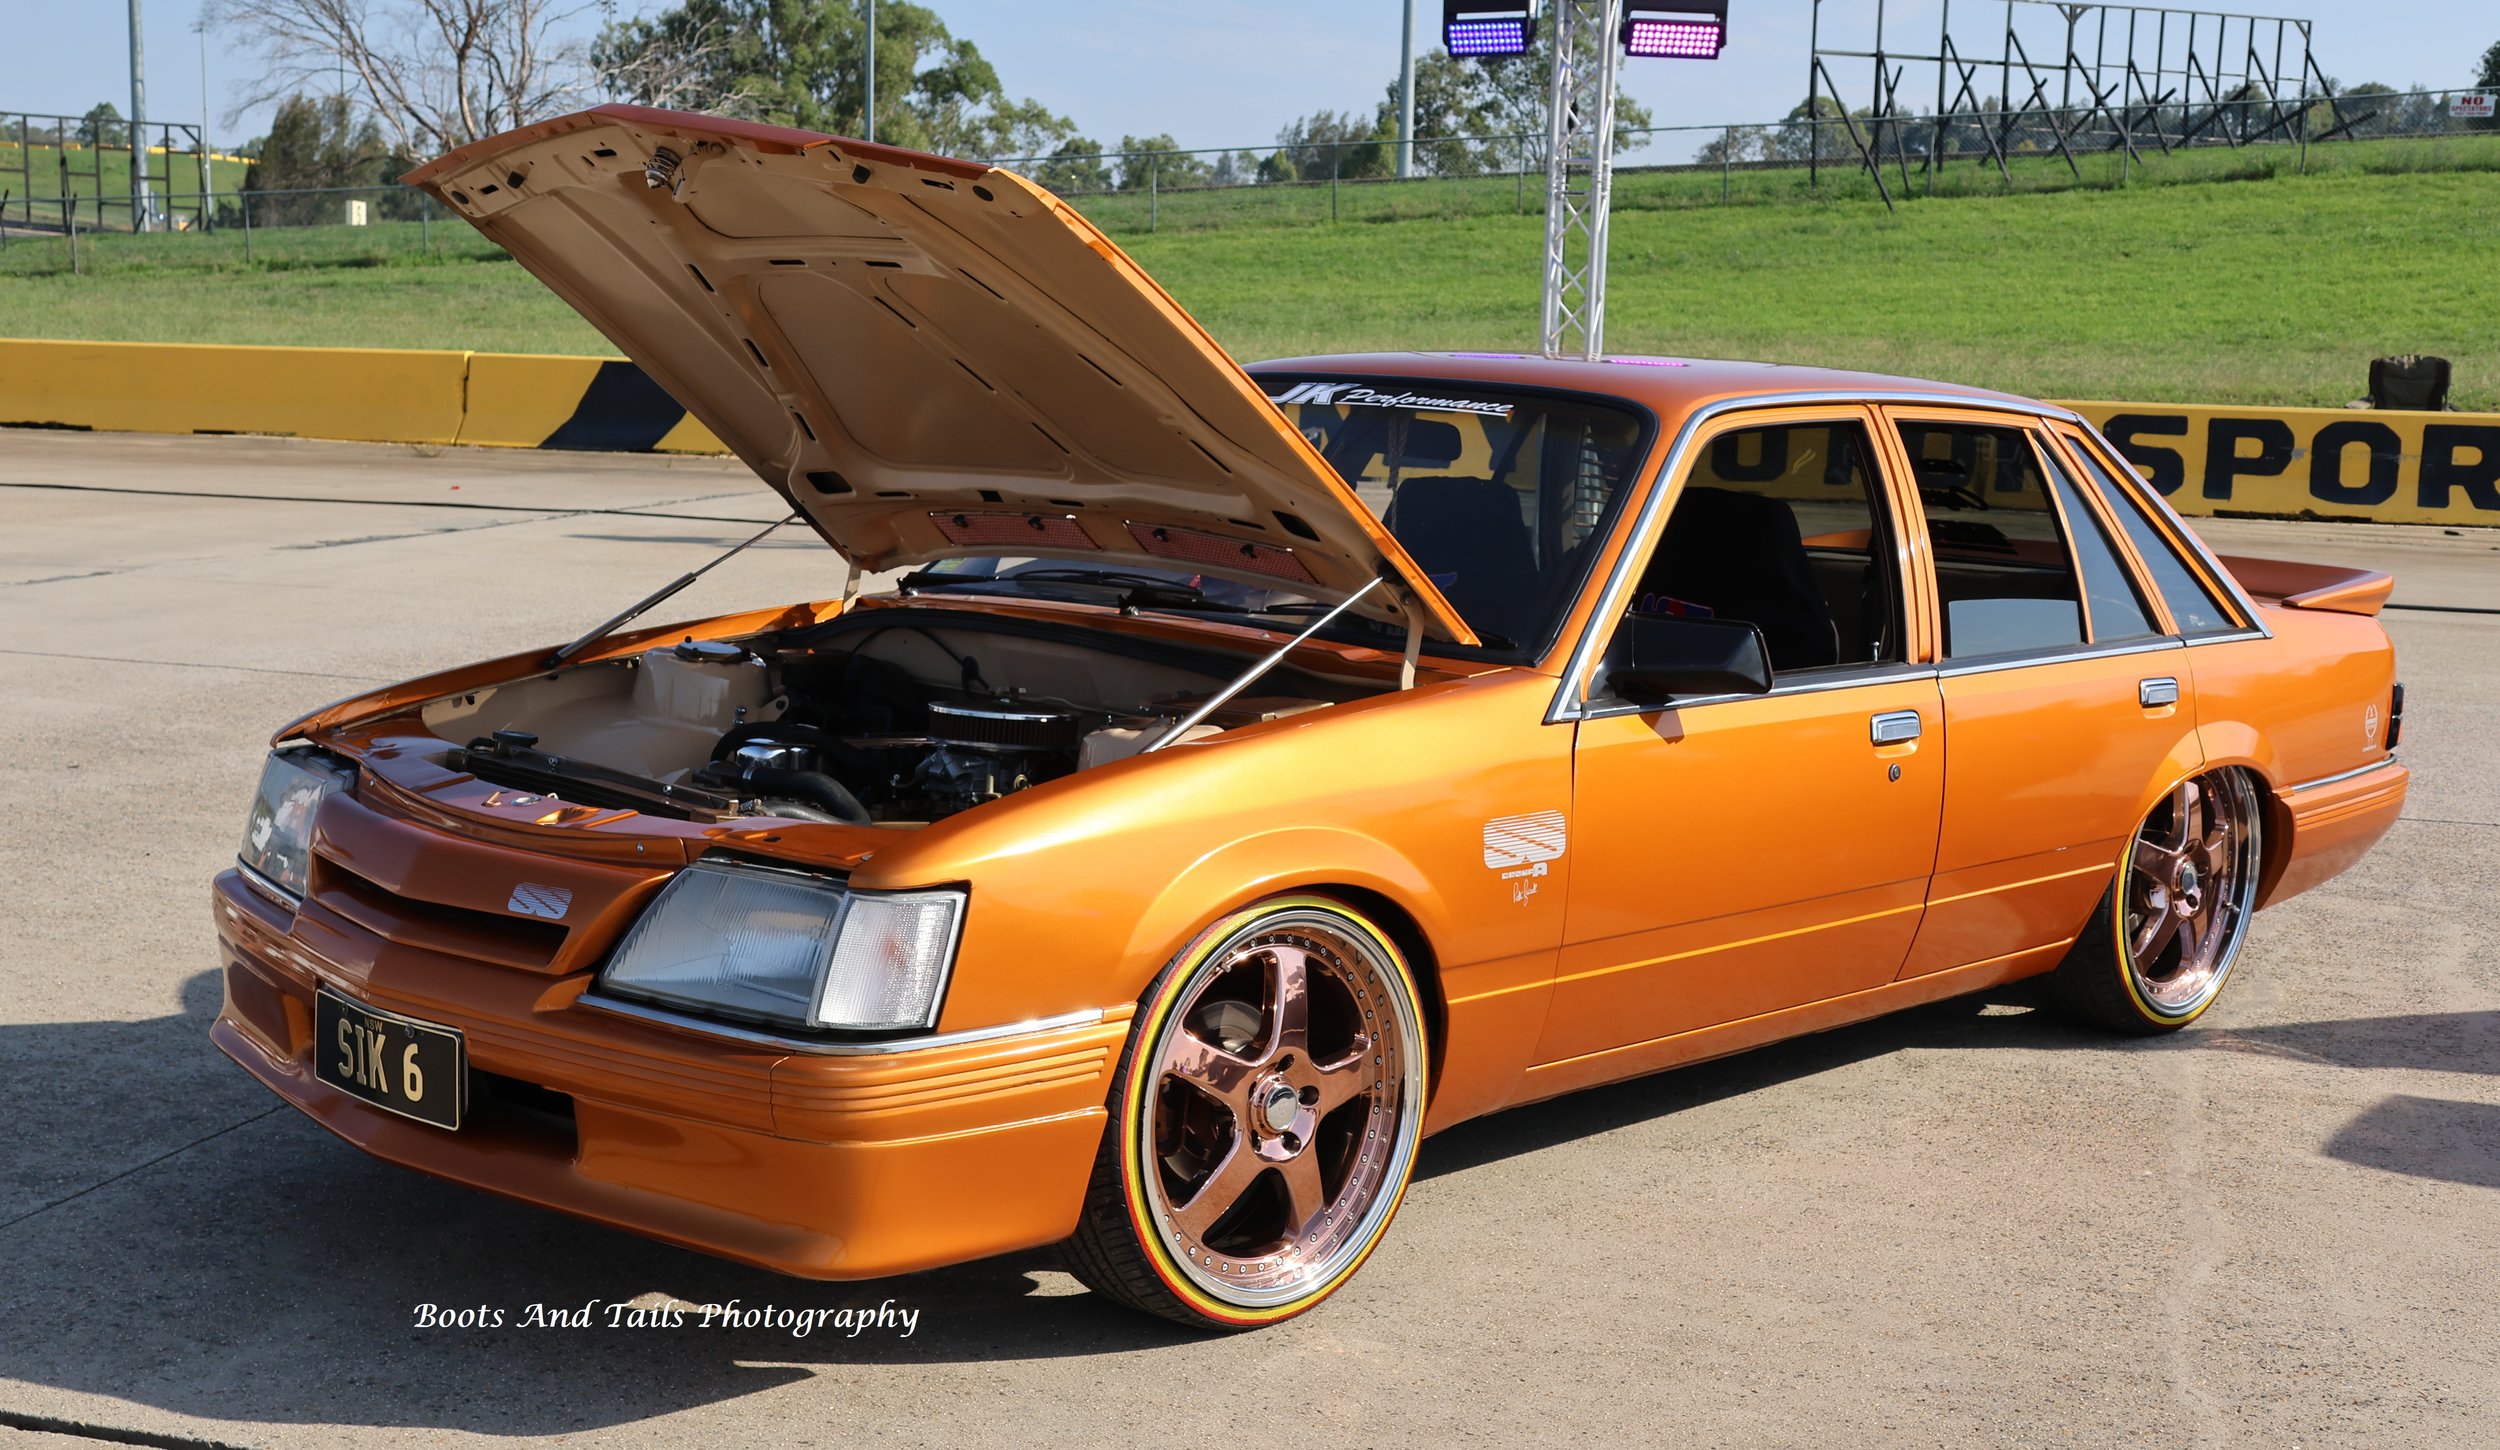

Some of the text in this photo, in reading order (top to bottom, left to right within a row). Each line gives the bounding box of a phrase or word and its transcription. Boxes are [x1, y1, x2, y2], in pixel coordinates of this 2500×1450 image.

[2462, 97, 2484, 105] NO
[1270, 382, 1515, 412] JK Performance
[364, 1016, 383, 1033] NSW
[337, 1018, 424, 1102] SIK 6
